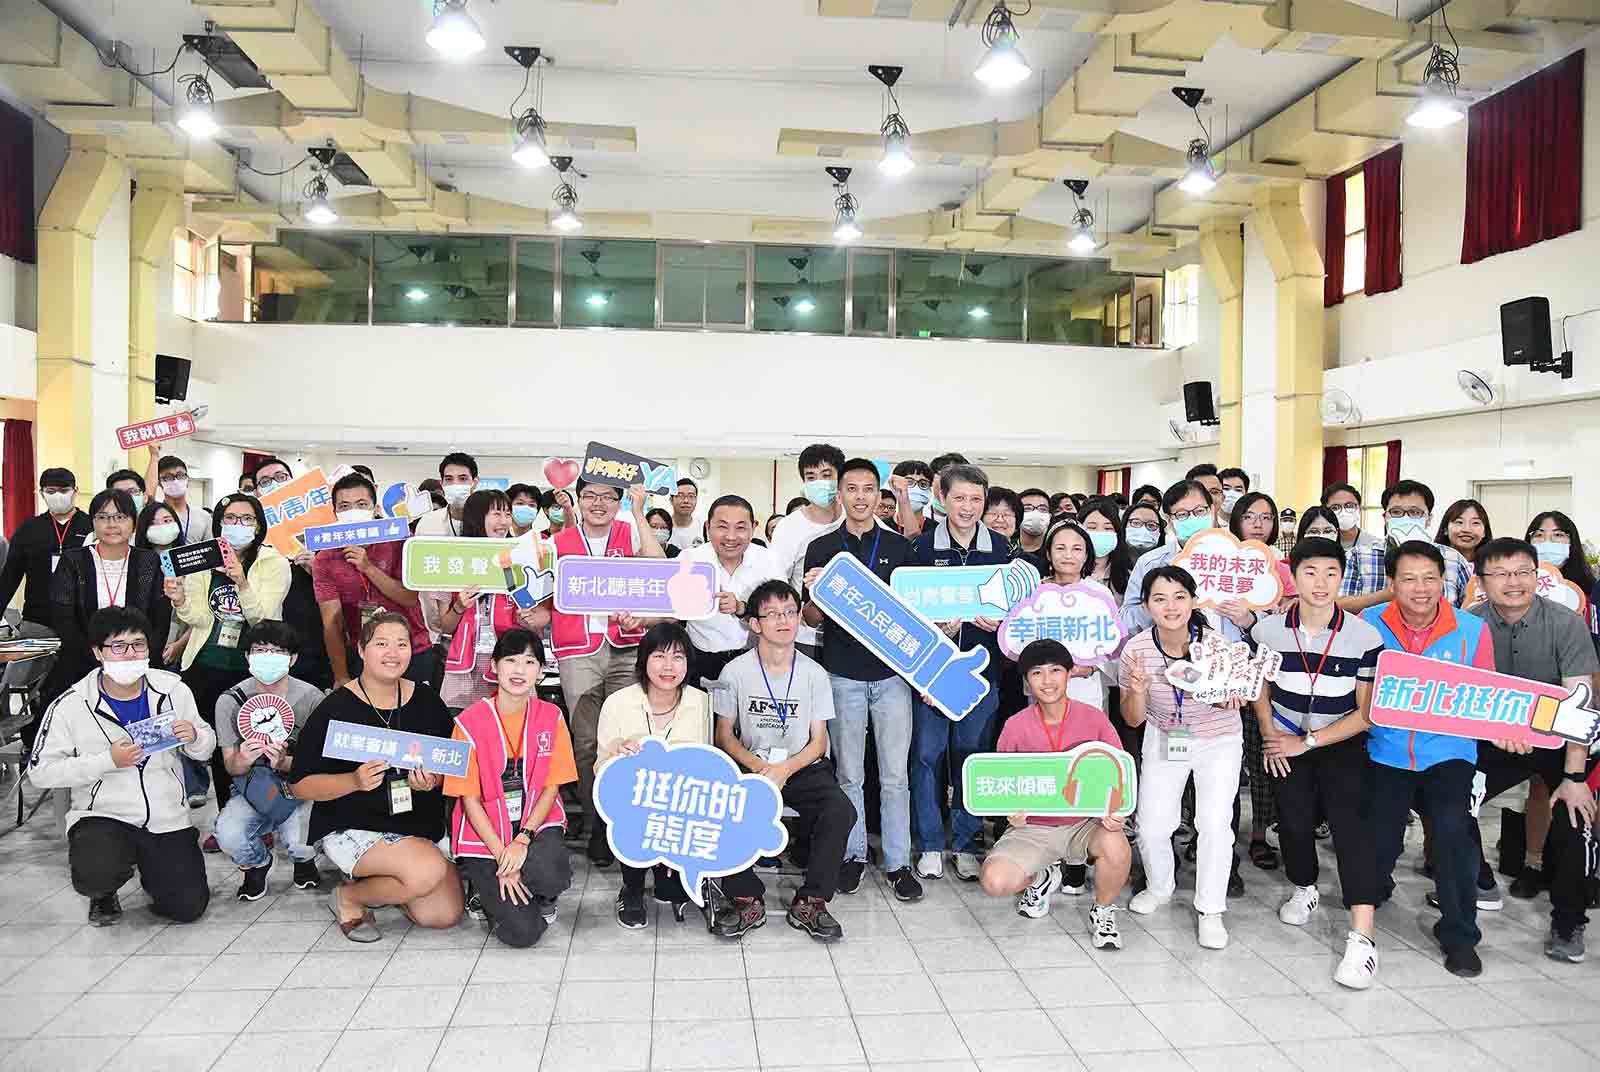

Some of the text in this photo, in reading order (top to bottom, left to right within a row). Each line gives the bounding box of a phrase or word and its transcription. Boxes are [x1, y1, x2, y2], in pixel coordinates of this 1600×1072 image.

[640, 462, 677, 495] YA
[1190, 553, 1265, 575] 我的未來
[567, 575, 666, 598] 新北聽青年
[1199, 574, 1254, 594] 不是夢
[827, 573, 921, 658] 青年公民審議
[1008, 615, 1116, 642] 幸福新北
[1376, 675, 1533, 725] 新北挺你
[431, 747, 462, 766] 新北
[632, 768, 747, 822] 挺你的
[976, 776, 1056, 797] 我來傾聽
[642, 813, 722, 860] 態度
